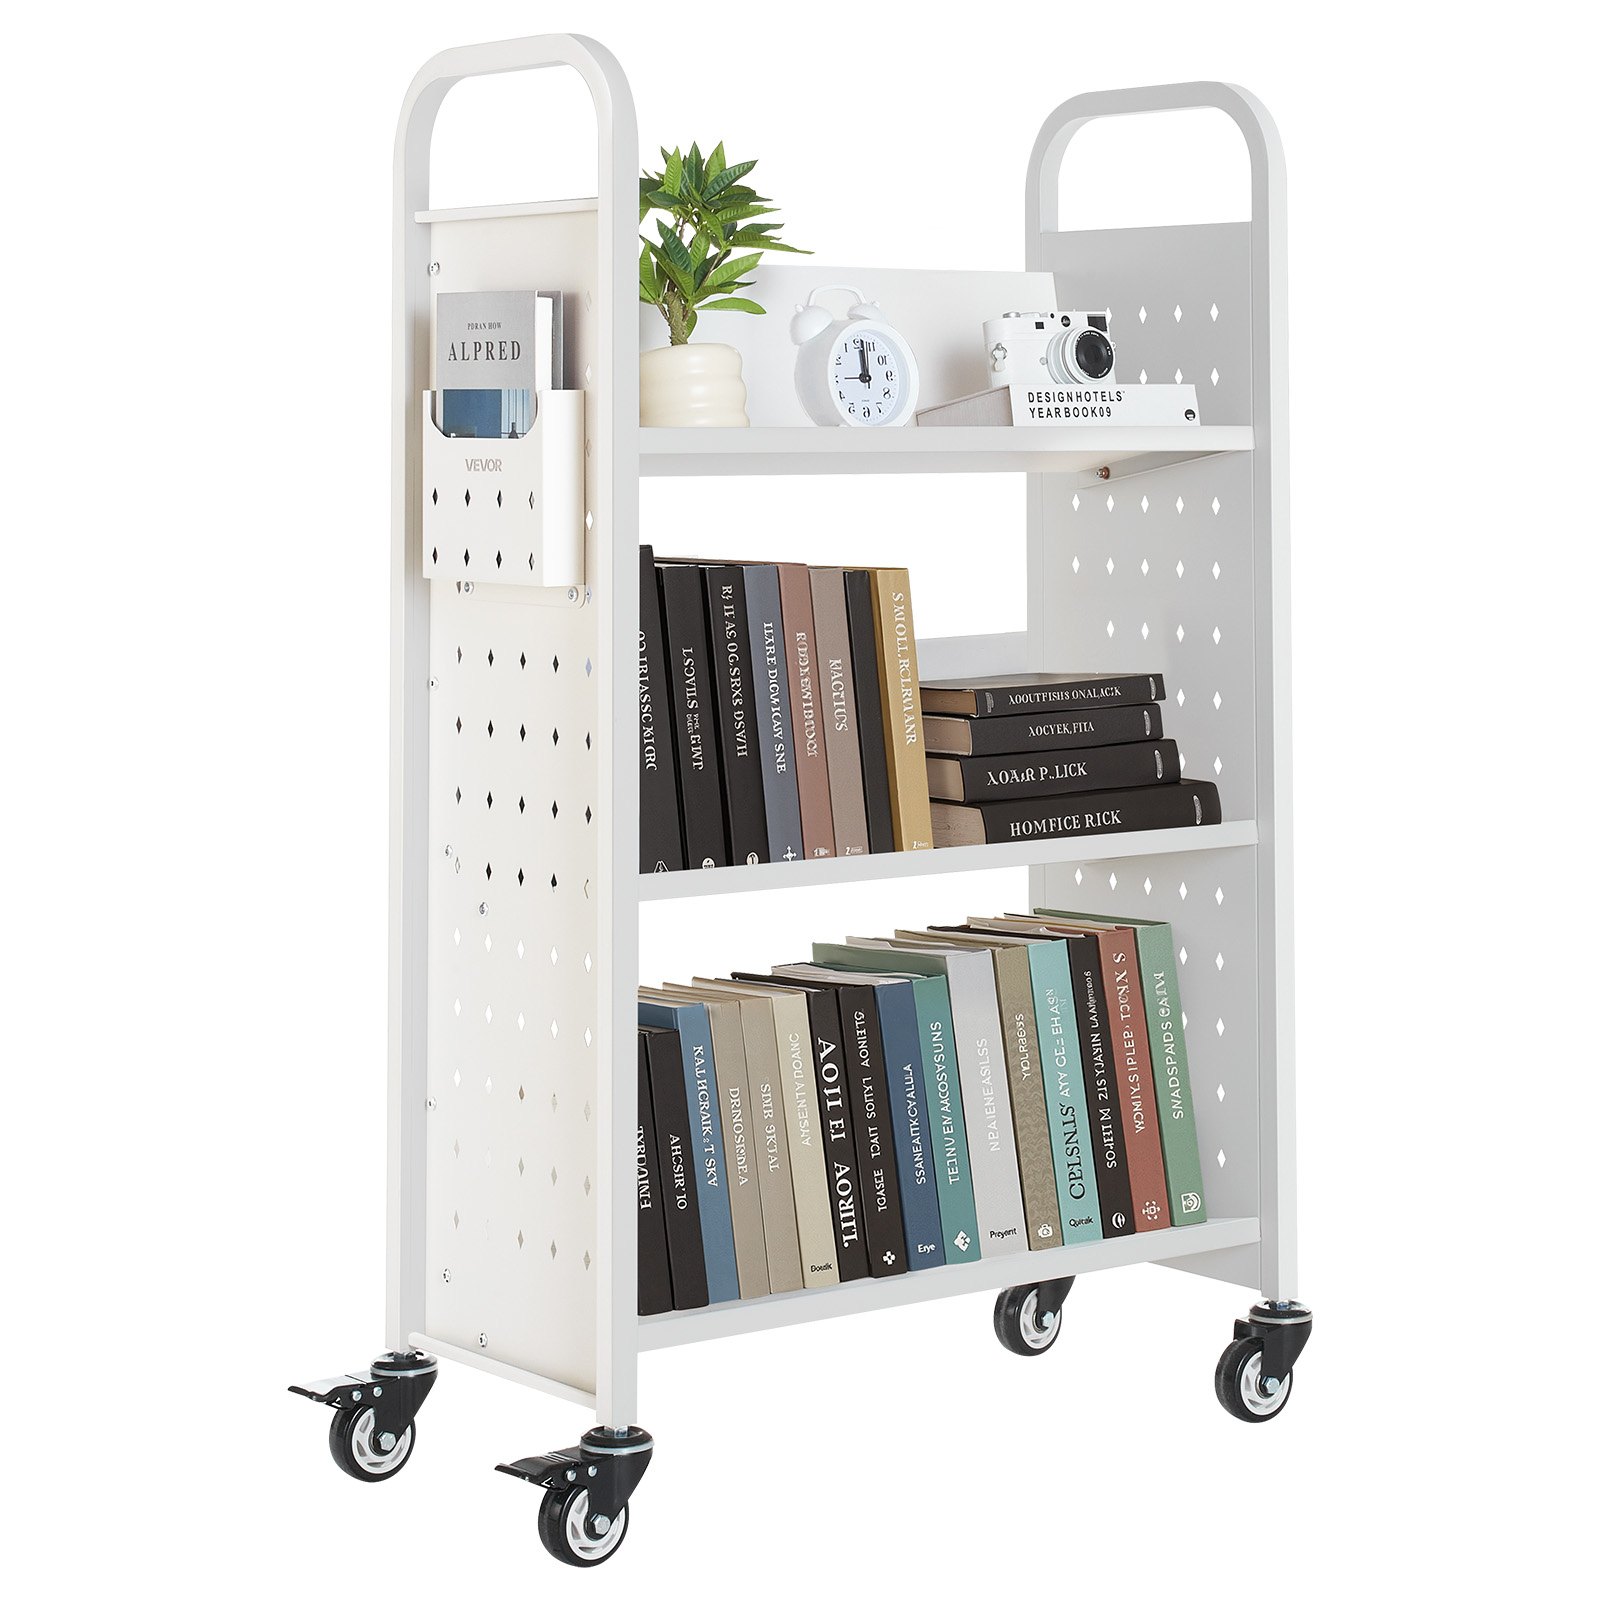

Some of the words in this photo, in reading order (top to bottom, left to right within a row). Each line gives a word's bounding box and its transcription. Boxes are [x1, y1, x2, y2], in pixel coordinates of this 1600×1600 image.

[448, 340, 521, 361] ALPRED
[464, 458, 503, 472] VEVOR
[1009, 814, 1081, 837] HOMFICE
[1084, 809, 1122, 827] RICK
